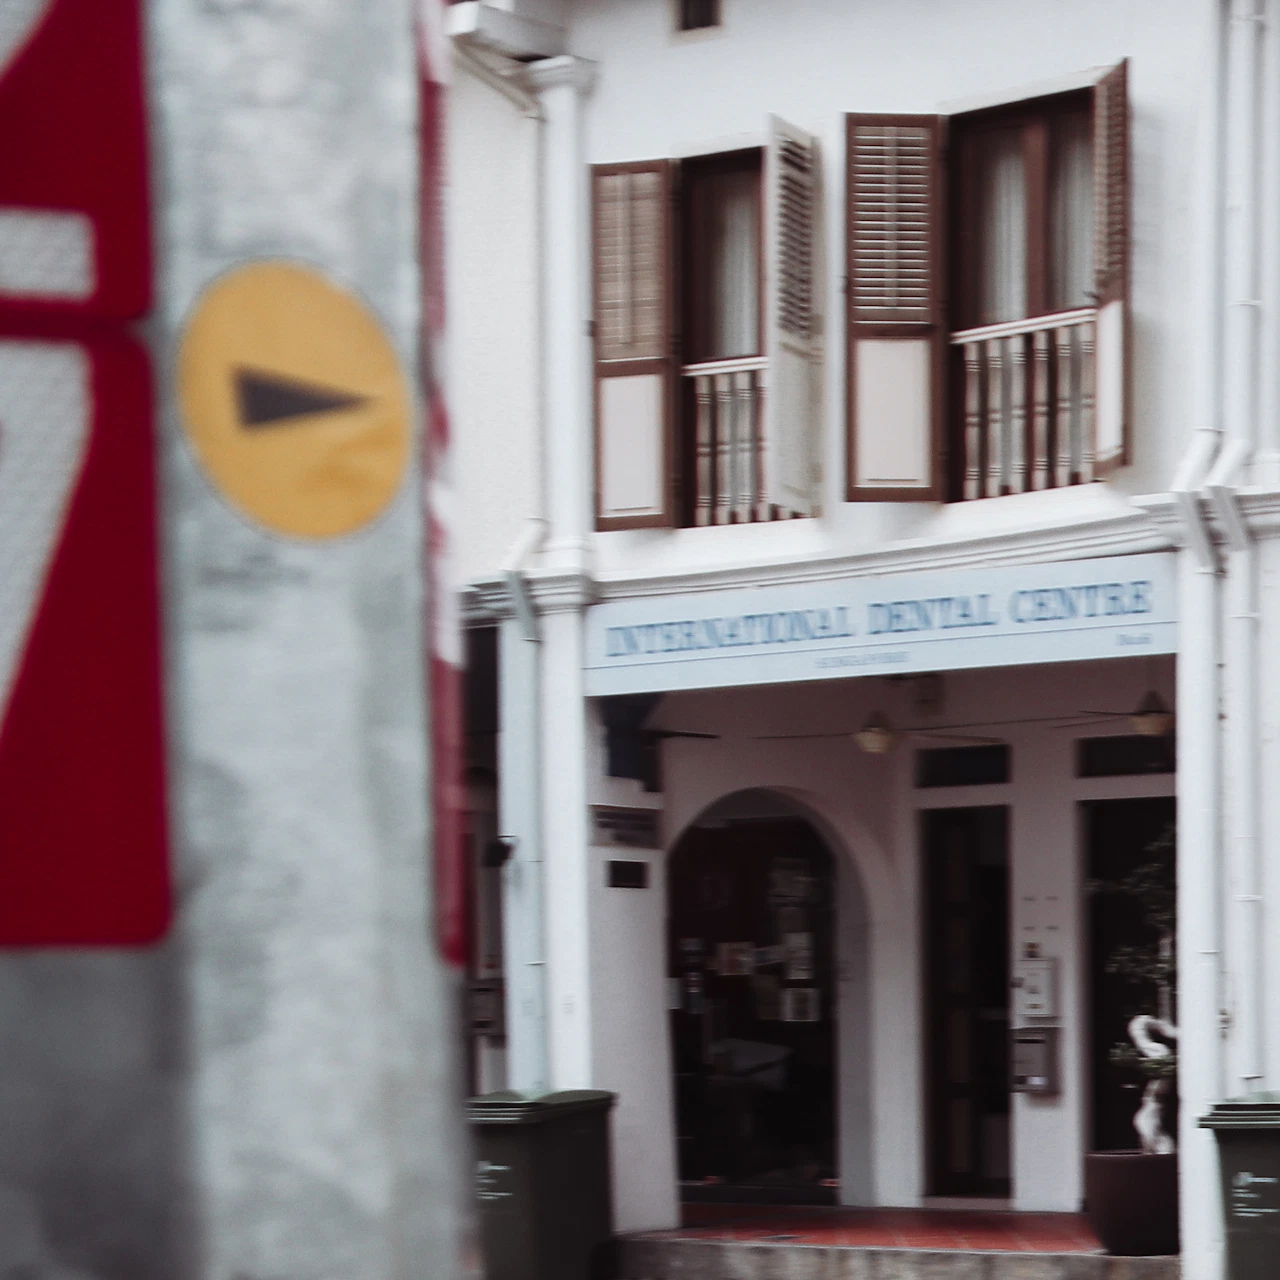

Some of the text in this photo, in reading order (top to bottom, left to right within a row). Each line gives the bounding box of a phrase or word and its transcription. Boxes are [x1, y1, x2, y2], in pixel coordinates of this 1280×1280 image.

[606, 579, 1152, 657] INTERNATIONAL DENTAL CENTRE
